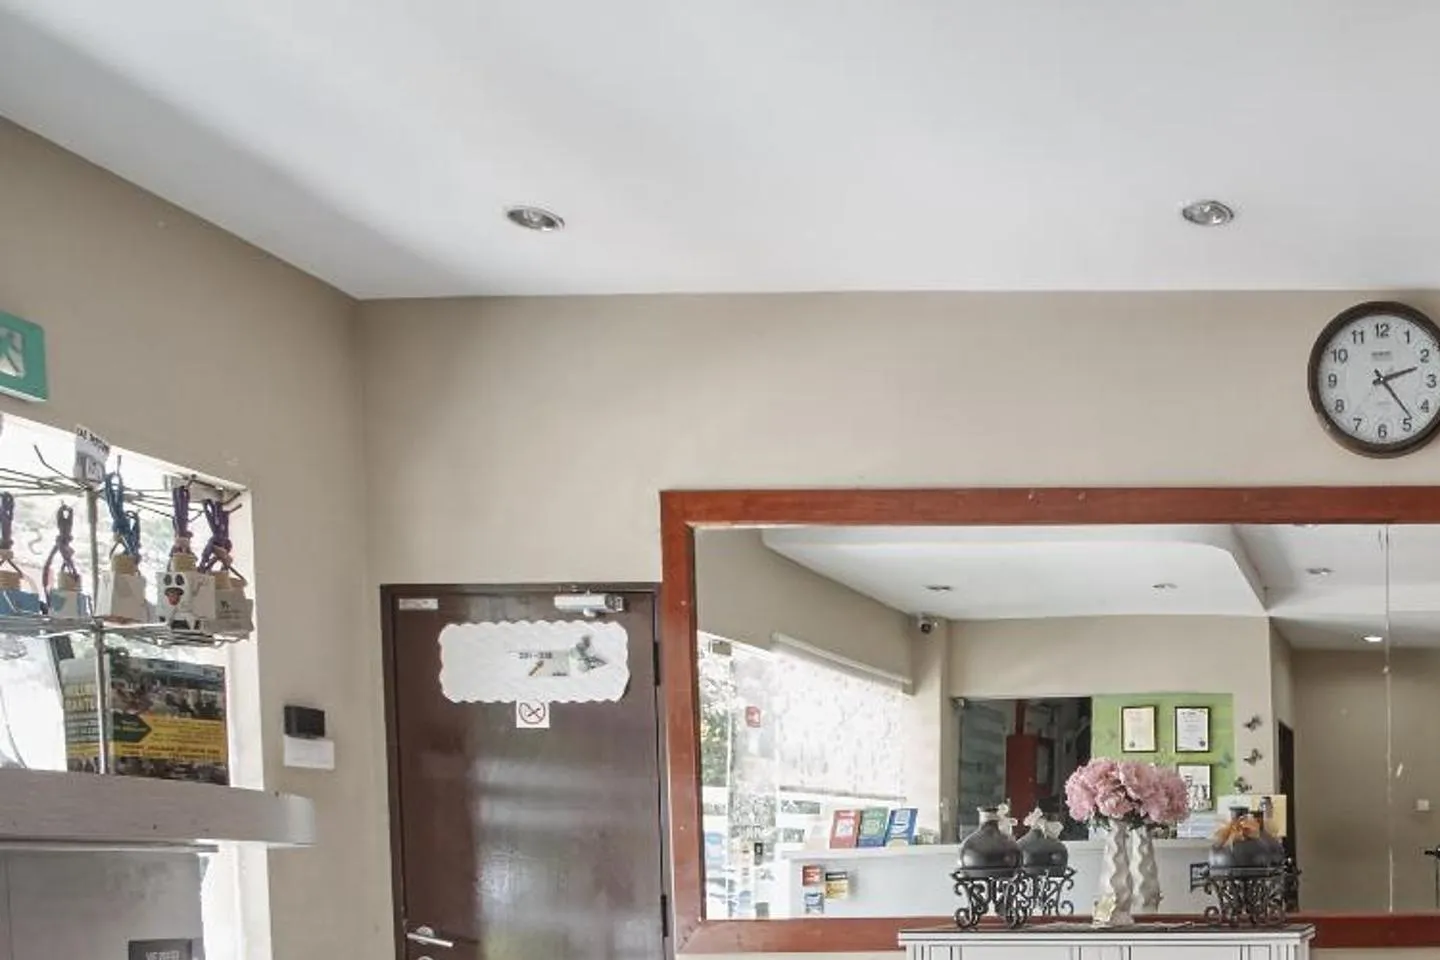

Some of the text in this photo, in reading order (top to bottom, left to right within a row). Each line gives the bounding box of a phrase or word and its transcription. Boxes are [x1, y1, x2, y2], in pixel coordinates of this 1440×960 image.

[1352, 330, 1365, 344] 11
[1375, 323, 1390, 337] 12
[1404, 330, 1411, 344] 1
[1332, 349, 1348, 363] 10
[1420, 349, 1430, 363] 2
[1328, 374, 1337, 387] 9
[1427, 374, 1437, 388] 3
[1335, 399, 1345, 413] 8
[1420, 399, 1430, 413] 4
[1353, 418, 1363, 431] 7
[1378, 424, 1388, 438] 6
[1402, 418, 1413, 432] 5
